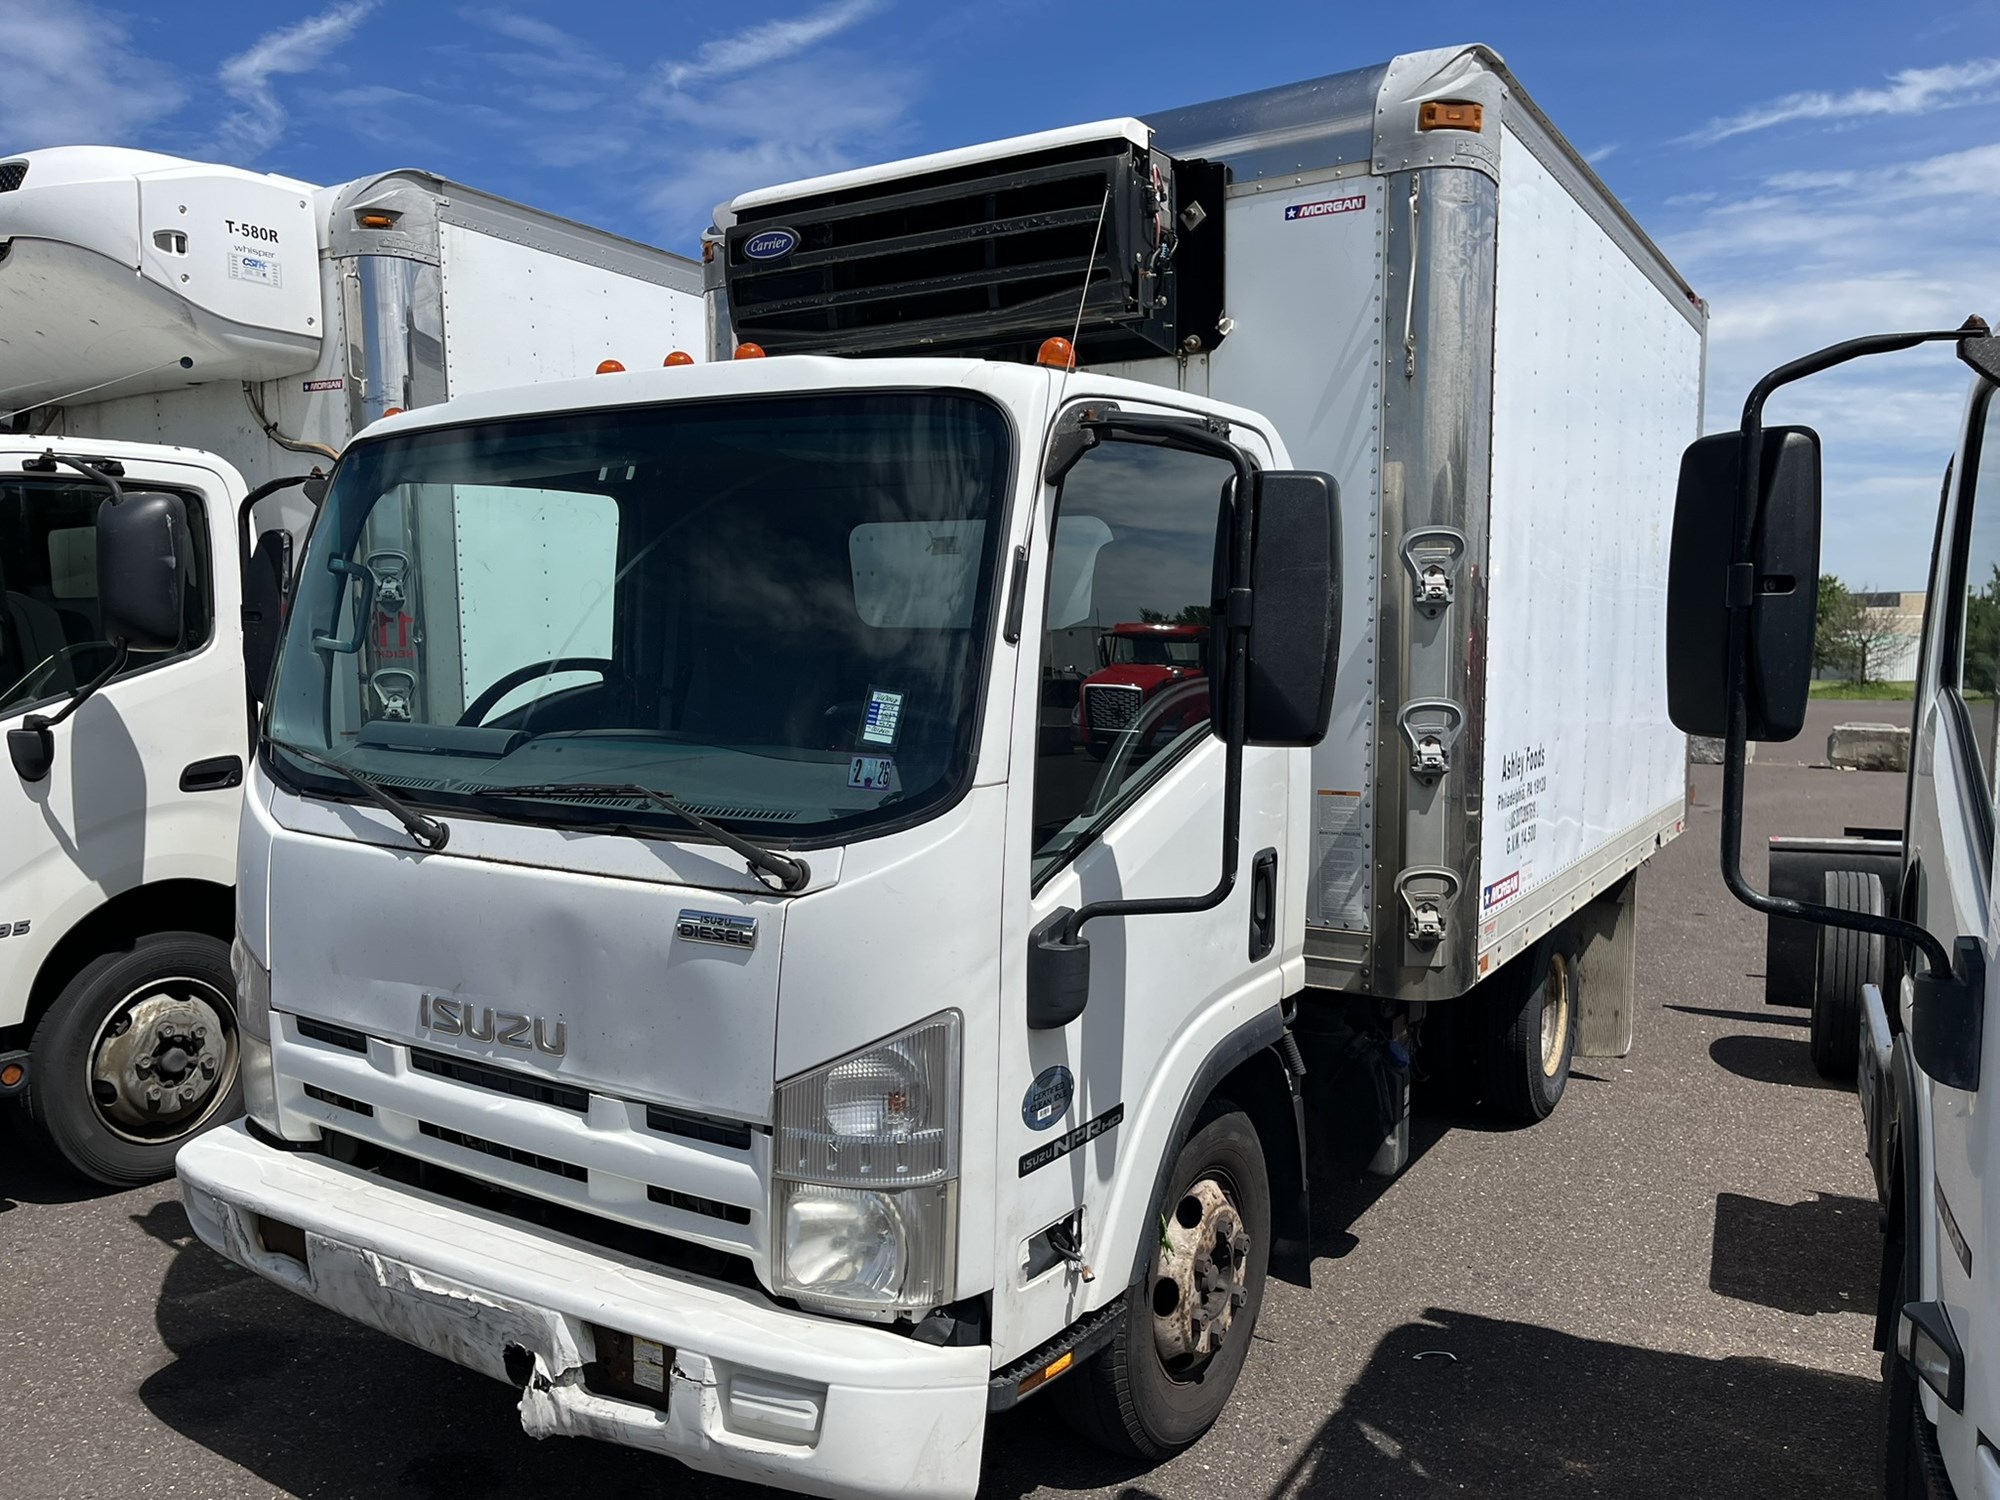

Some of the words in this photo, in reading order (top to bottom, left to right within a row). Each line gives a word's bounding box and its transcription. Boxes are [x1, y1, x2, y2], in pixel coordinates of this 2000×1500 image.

[1299, 198, 1364, 217] MORGAN
[225, 219, 279, 244] T-580R
[234, 245, 276, 259] whisper
[750, 237, 787, 253] Carrier
[310, 380, 342, 390] MORGAN
[853, 759, 863, 783] 2
[877, 761, 891, 785] 26
[1501, 750, 1525, 782] Ashley
[1525, 743, 1545, 772] Foods
[1527, 781, 1533, 798] PA
[1490, 874, 1519, 904] MORGAN
[700, 915, 732, 927] ISUZU
[680, 923, 754, 945] DIESEL
[420, 993, 568, 1058] ISUZU
[1029, 1097, 1052, 1113] CLEAN
[1054, 1089, 1069, 1101] IDLE
[1033, 1081, 1065, 1102] CERTIFIED
[1023, 1147, 1052, 1171] ISUZU
[1053, 1118, 1102, 1158] NPR
[1102, 1113, 1122, 1131] HD
